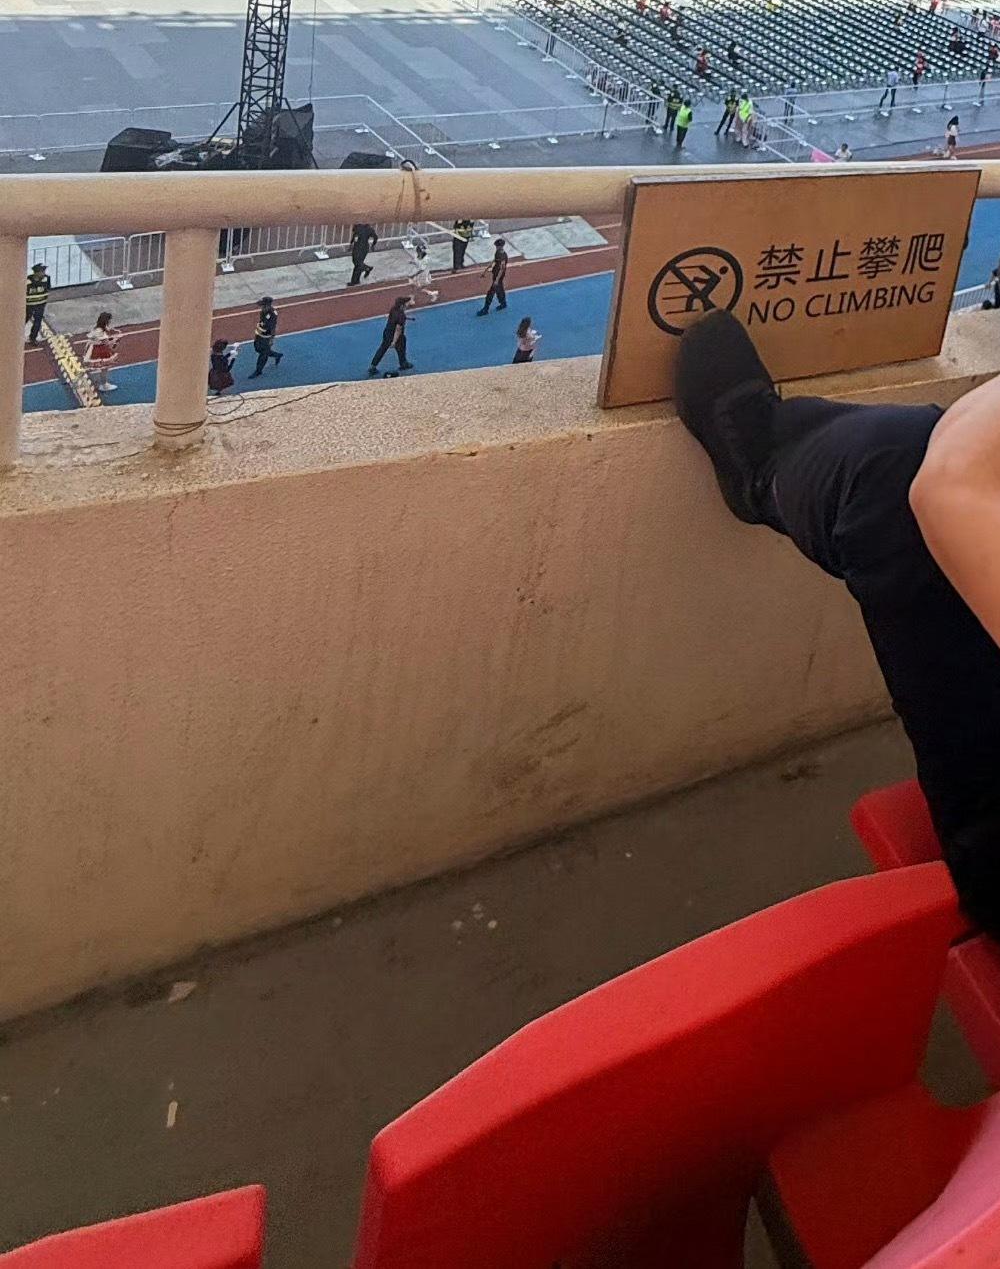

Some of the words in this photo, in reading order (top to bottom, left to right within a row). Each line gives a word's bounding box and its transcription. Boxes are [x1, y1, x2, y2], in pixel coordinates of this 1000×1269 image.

[754, 233, 944, 290] 禁止攀爬
[748, 298, 795, 325] NO
[805, 281, 936, 318] CLIMBING
